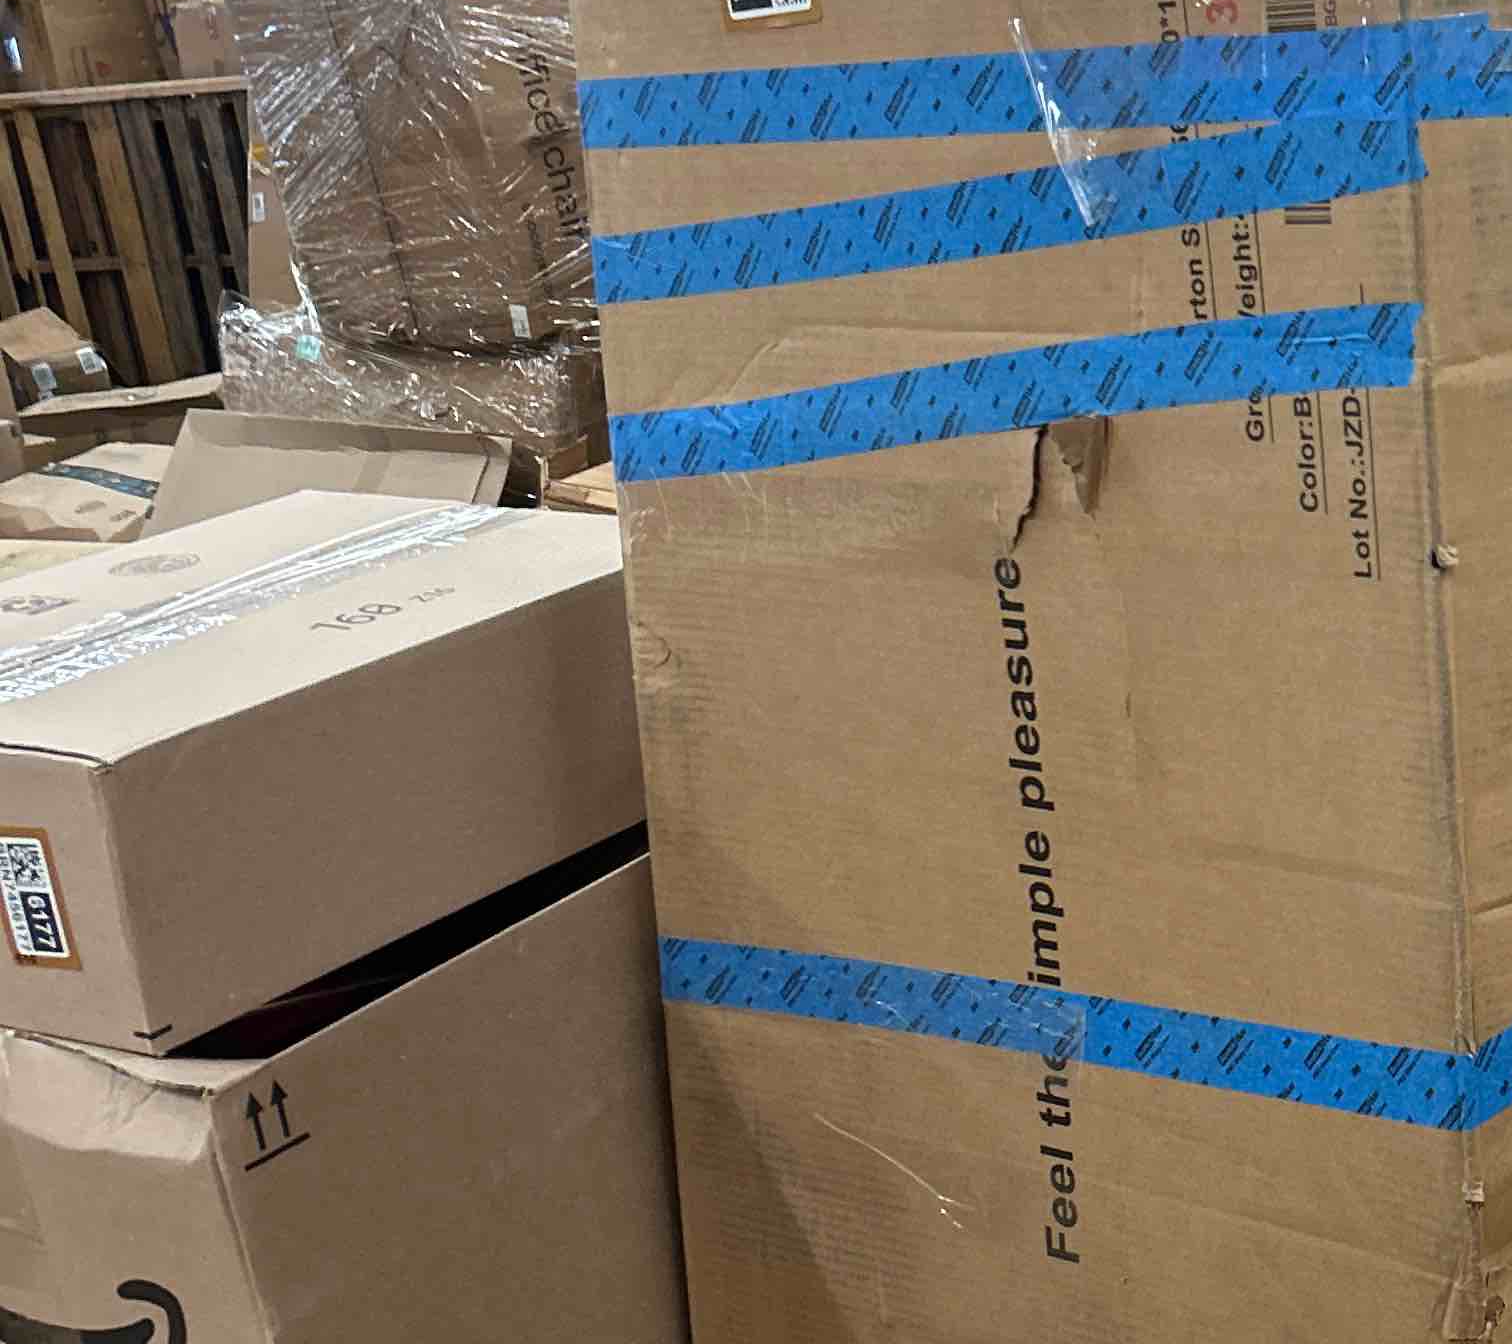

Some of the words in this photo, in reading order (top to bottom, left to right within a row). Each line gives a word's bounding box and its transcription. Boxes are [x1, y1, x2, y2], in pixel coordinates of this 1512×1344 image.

[1189, 259, 1208, 320] rton
[1353, 529, 1372, 579] Lot
[994, 557, 1055, 812] pleasure
[27, 895, 57, 949] 6177
[1018, 830, 1065, 987] imple
[1040, 1144, 1080, 1264] Feel
